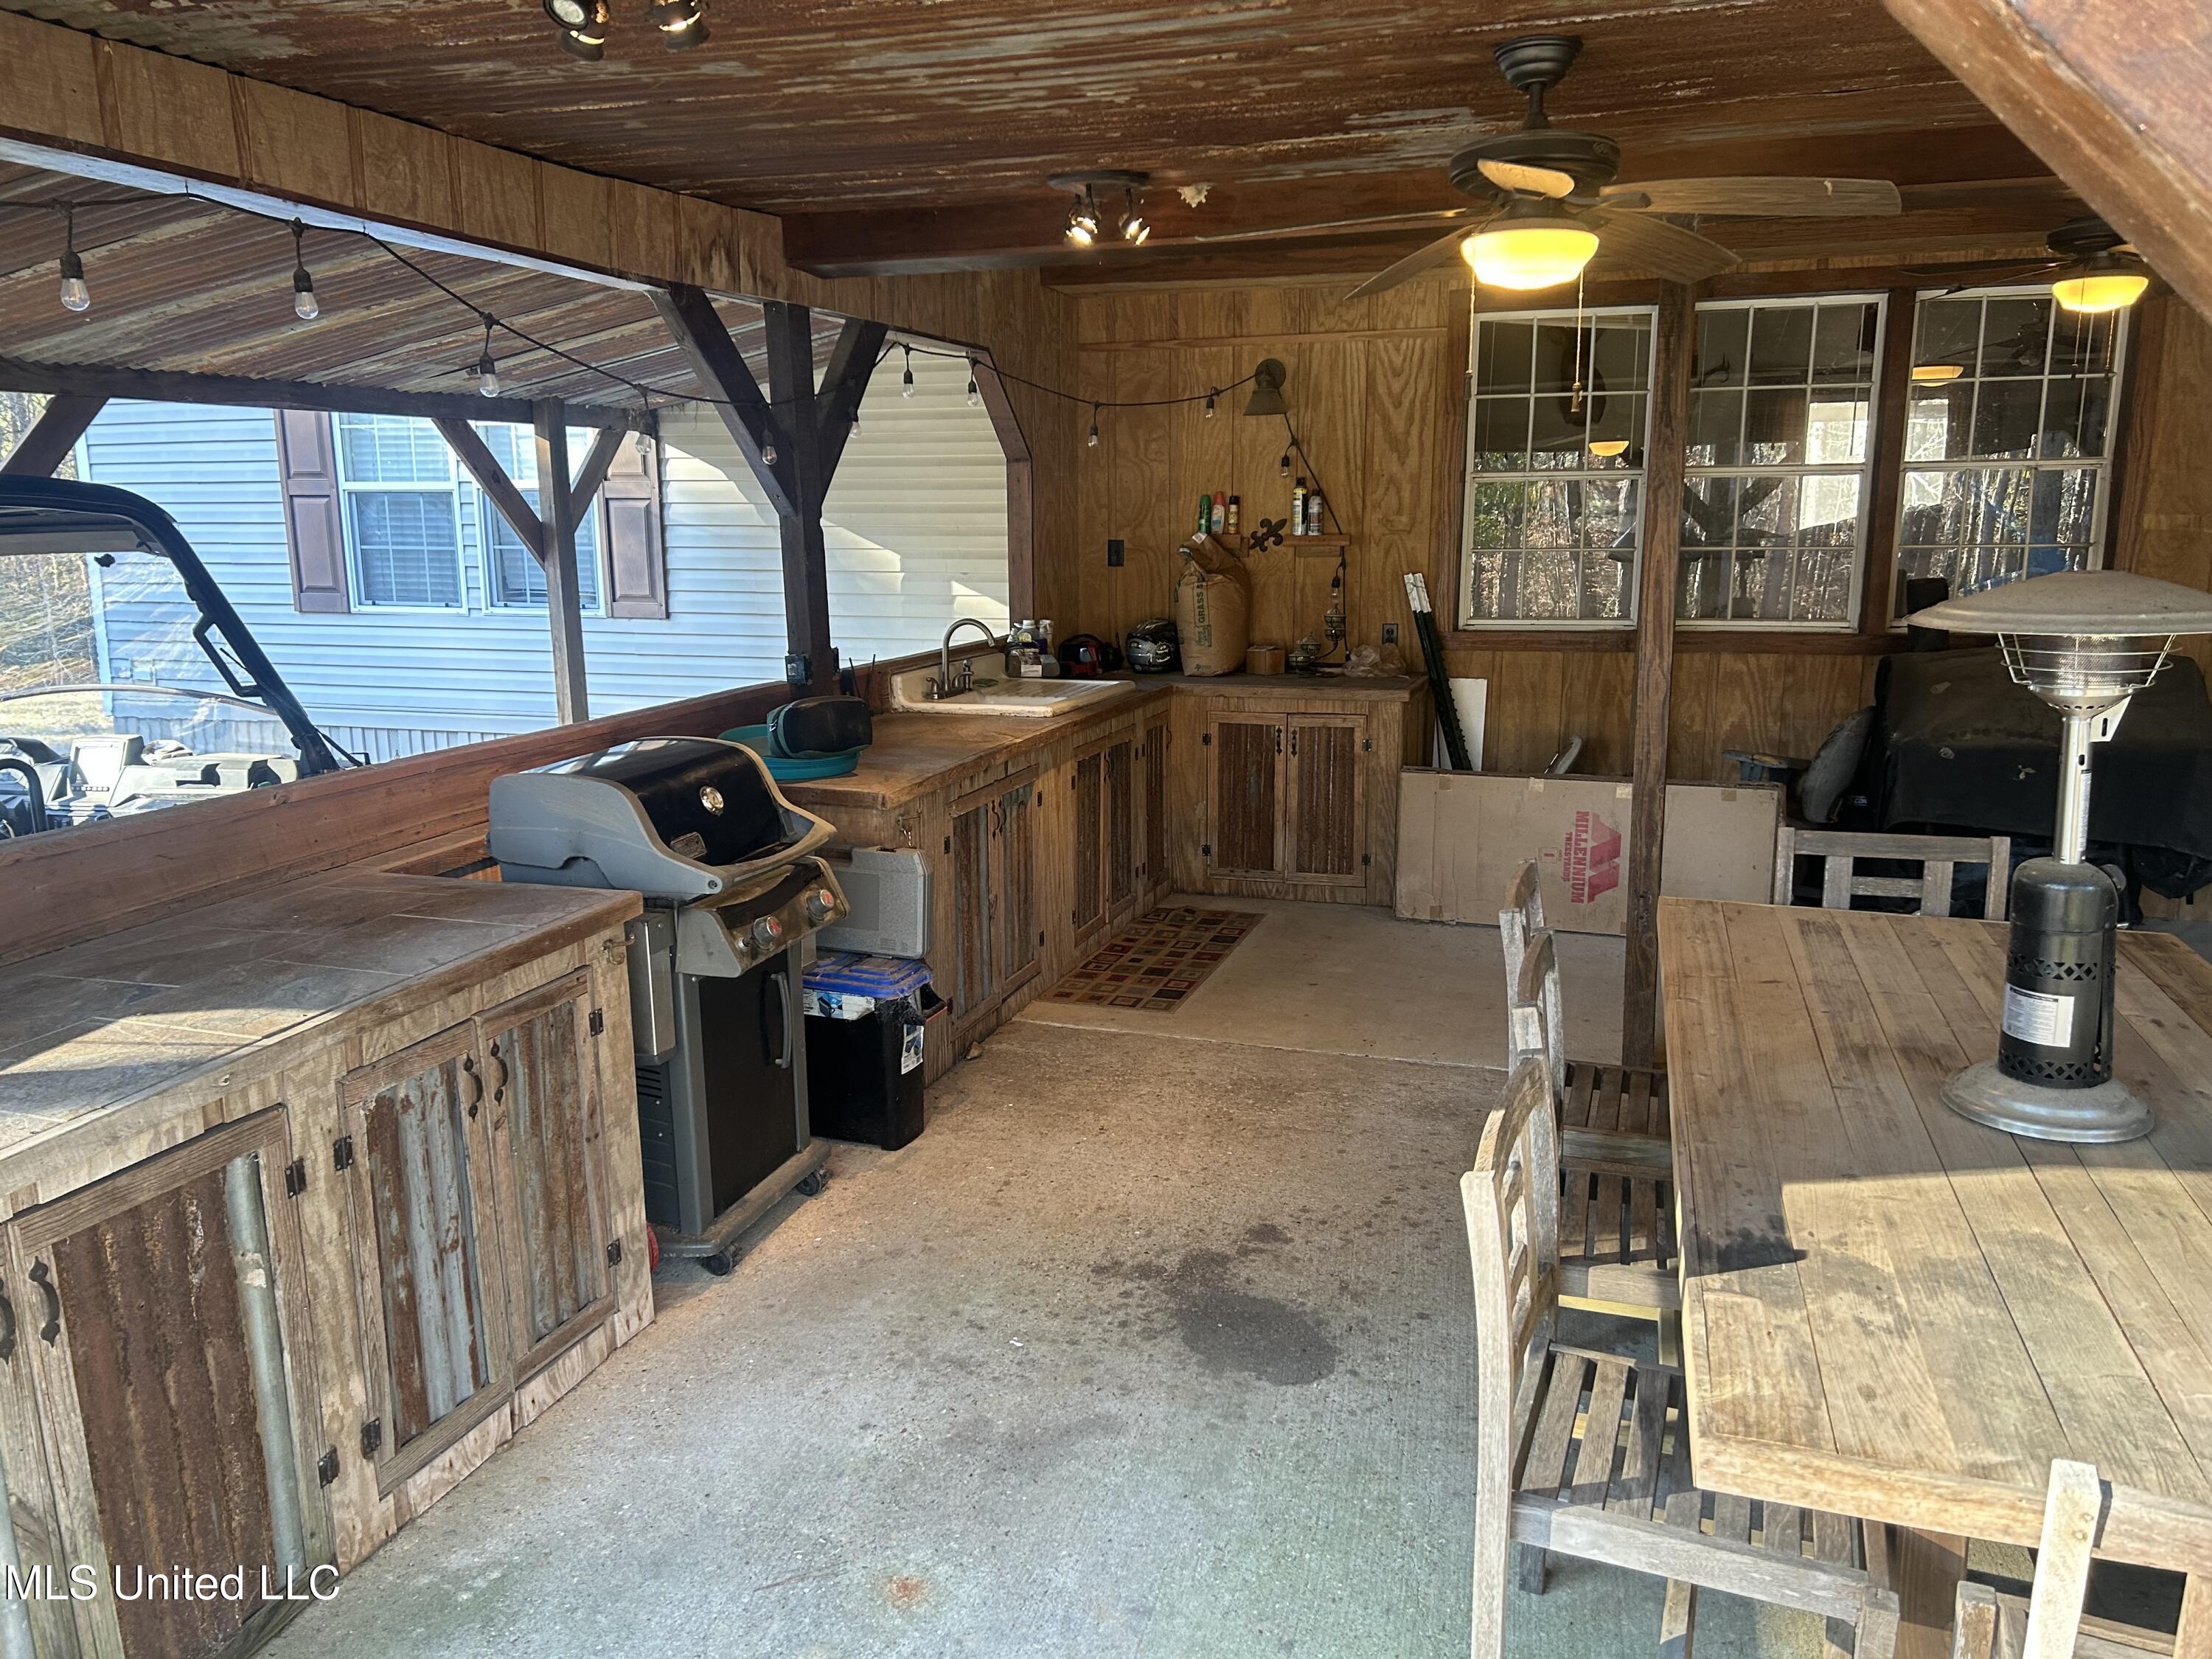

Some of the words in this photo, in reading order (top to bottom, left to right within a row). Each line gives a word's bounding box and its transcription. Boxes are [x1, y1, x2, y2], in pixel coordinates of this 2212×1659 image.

[1197, 591, 1205, 623] GRASS
[1562, 831, 1573, 883] TREESTANDS
[1571, 810, 1590, 904] MILLENNIUM
